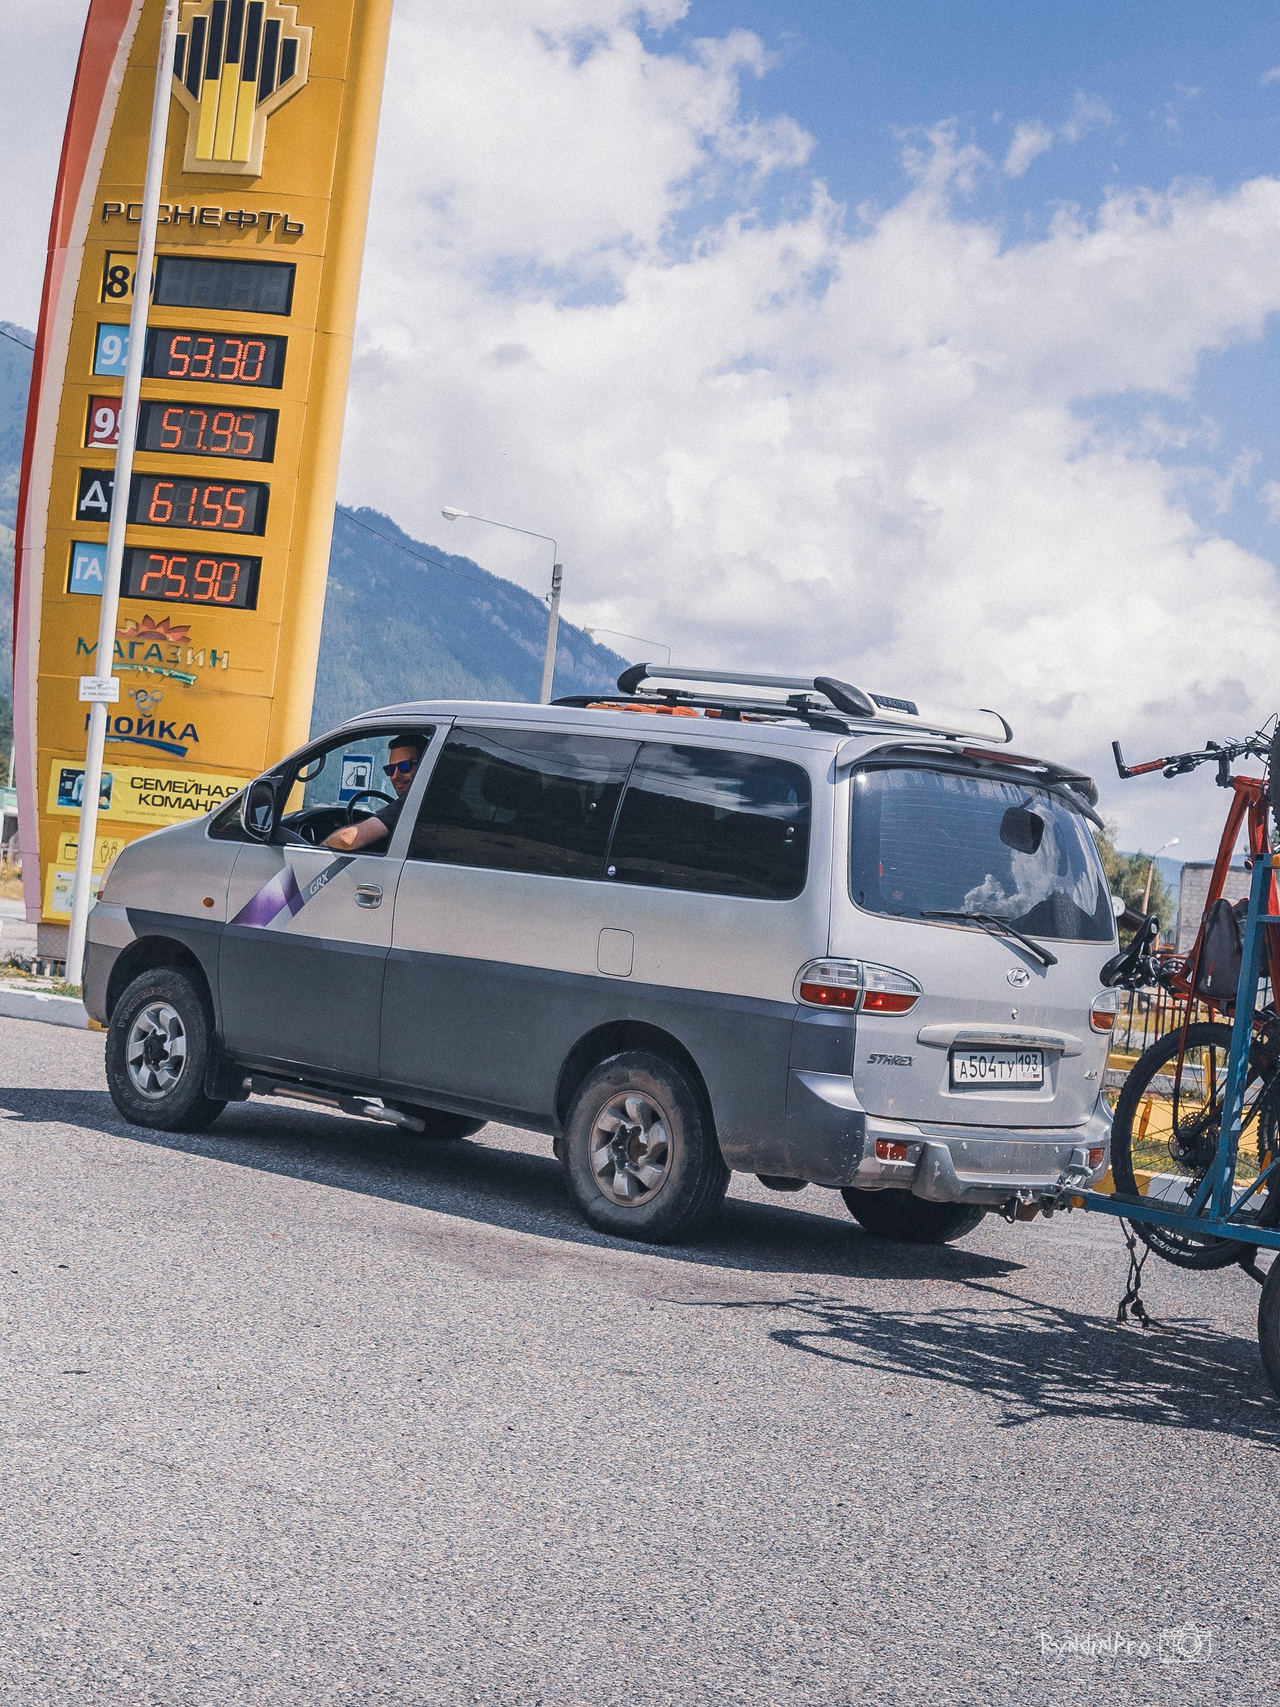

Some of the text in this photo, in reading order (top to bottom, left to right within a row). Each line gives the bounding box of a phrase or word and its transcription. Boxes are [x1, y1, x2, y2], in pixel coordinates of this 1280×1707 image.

[102, 202, 306, 235] РОСНЕФТЬ
[168, 335, 267, 381] 53.30
[93, 407, 123, 440] 9
[160, 408, 256, 454] 57.95
[80, 480, 115, 513] Д
[148, 482, 247, 528] 61.55
[74, 556, 107, 582] ГА
[130, 776, 239, 798] СЕМЕЙНАЯ
[138, 793, 222, 812] КОМАНД
[310, 870, 329, 895] GRX
[866, 1052, 917, 1067] STAREX
[1018, 1054, 1038, 1072] 193
